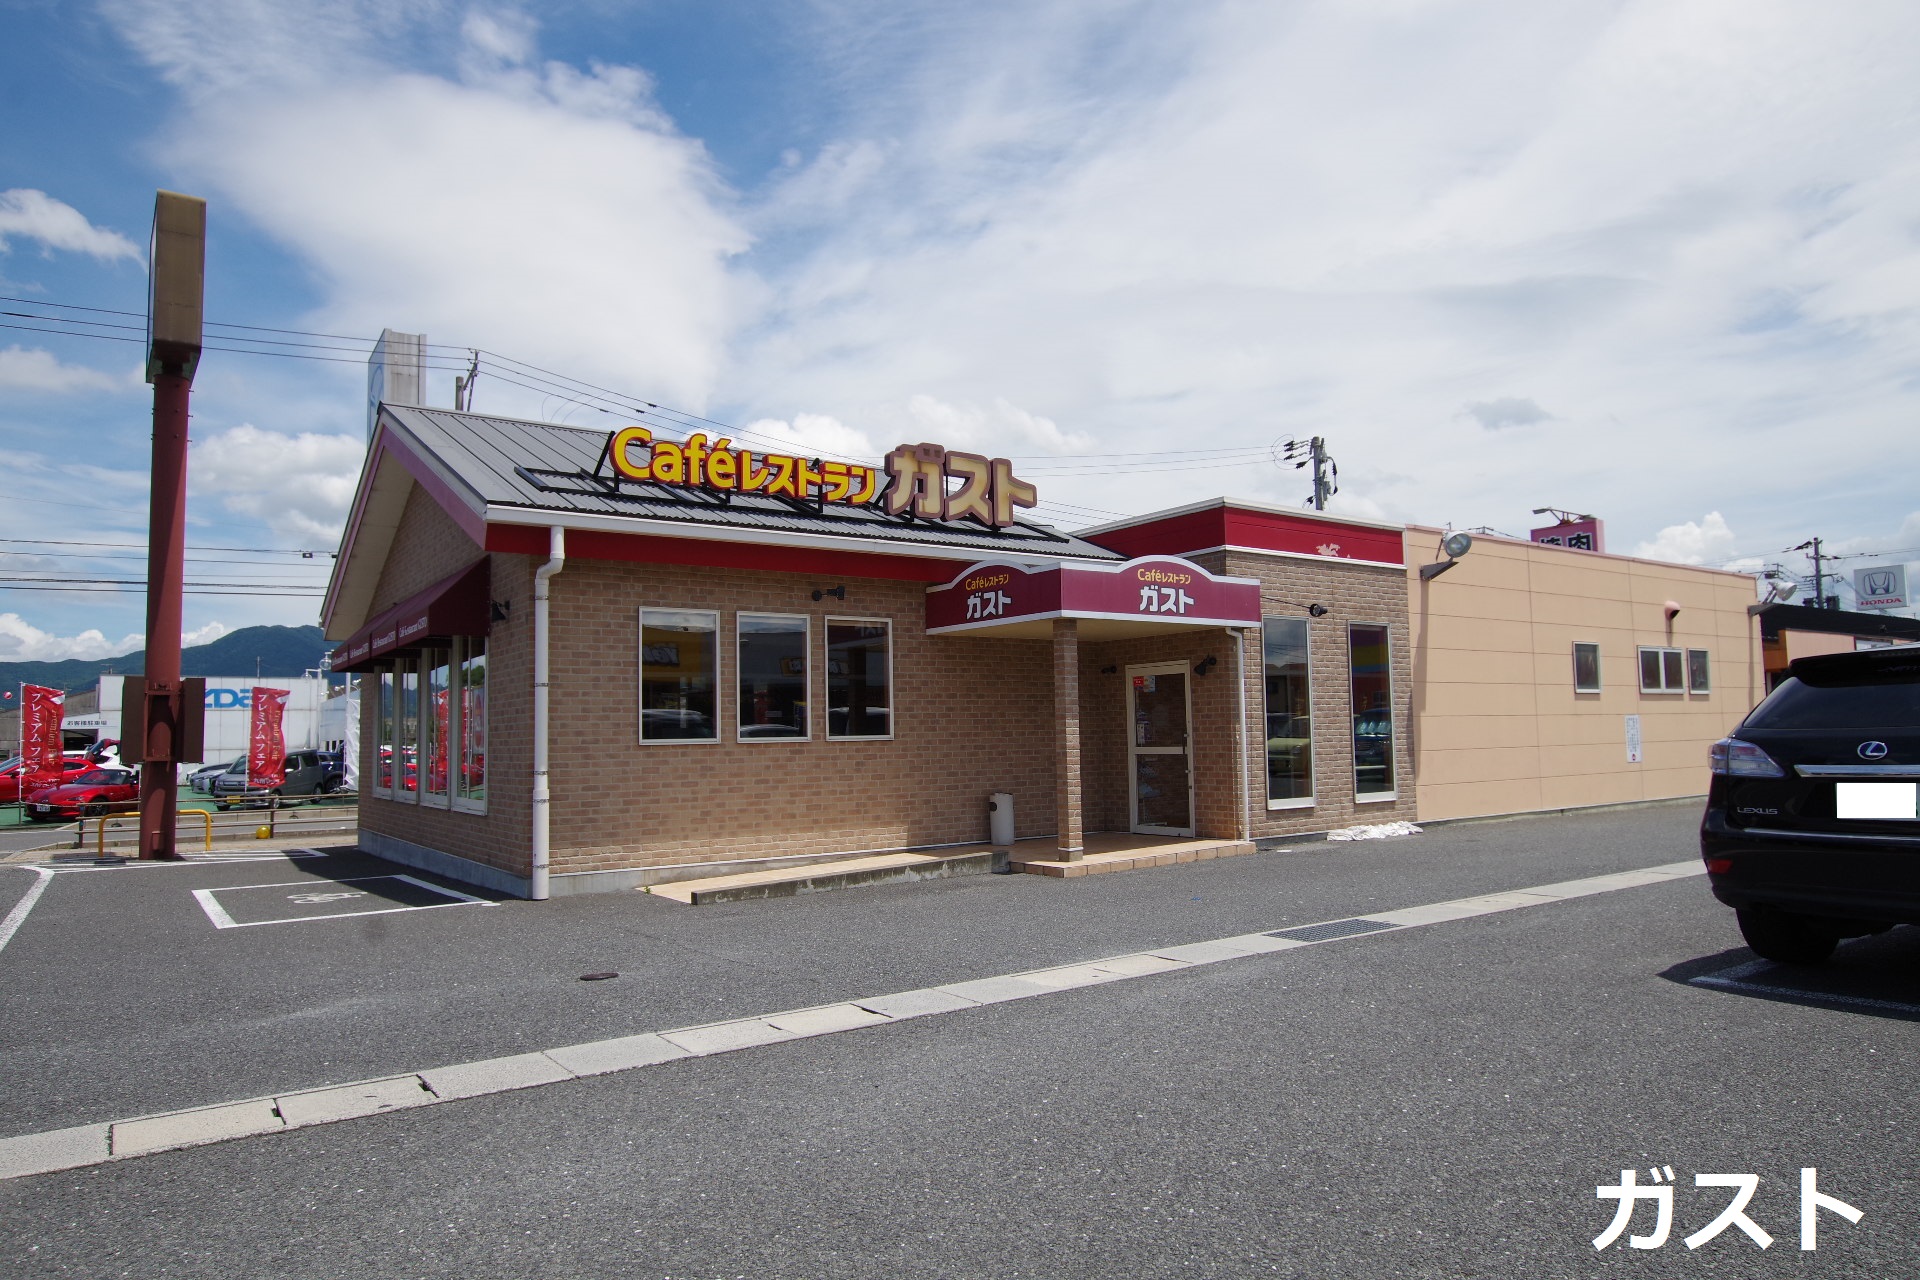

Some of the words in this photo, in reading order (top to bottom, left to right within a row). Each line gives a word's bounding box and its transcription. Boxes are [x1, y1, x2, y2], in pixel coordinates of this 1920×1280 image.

[884, 443, 1037, 527] ガスト
[966, 590, 1012, 619] ガスト
[1139, 585, 1194, 613] ガスト
[1860, 598, 1902, 606] HONDA
[30, 693, 43, 742] プレミアム
[256, 694, 268, 739] プレミアム
[30, 747, 41, 773] フェア
[255, 743, 266, 770] フェア
[1737, 807, 1778, 815] LEXUS
